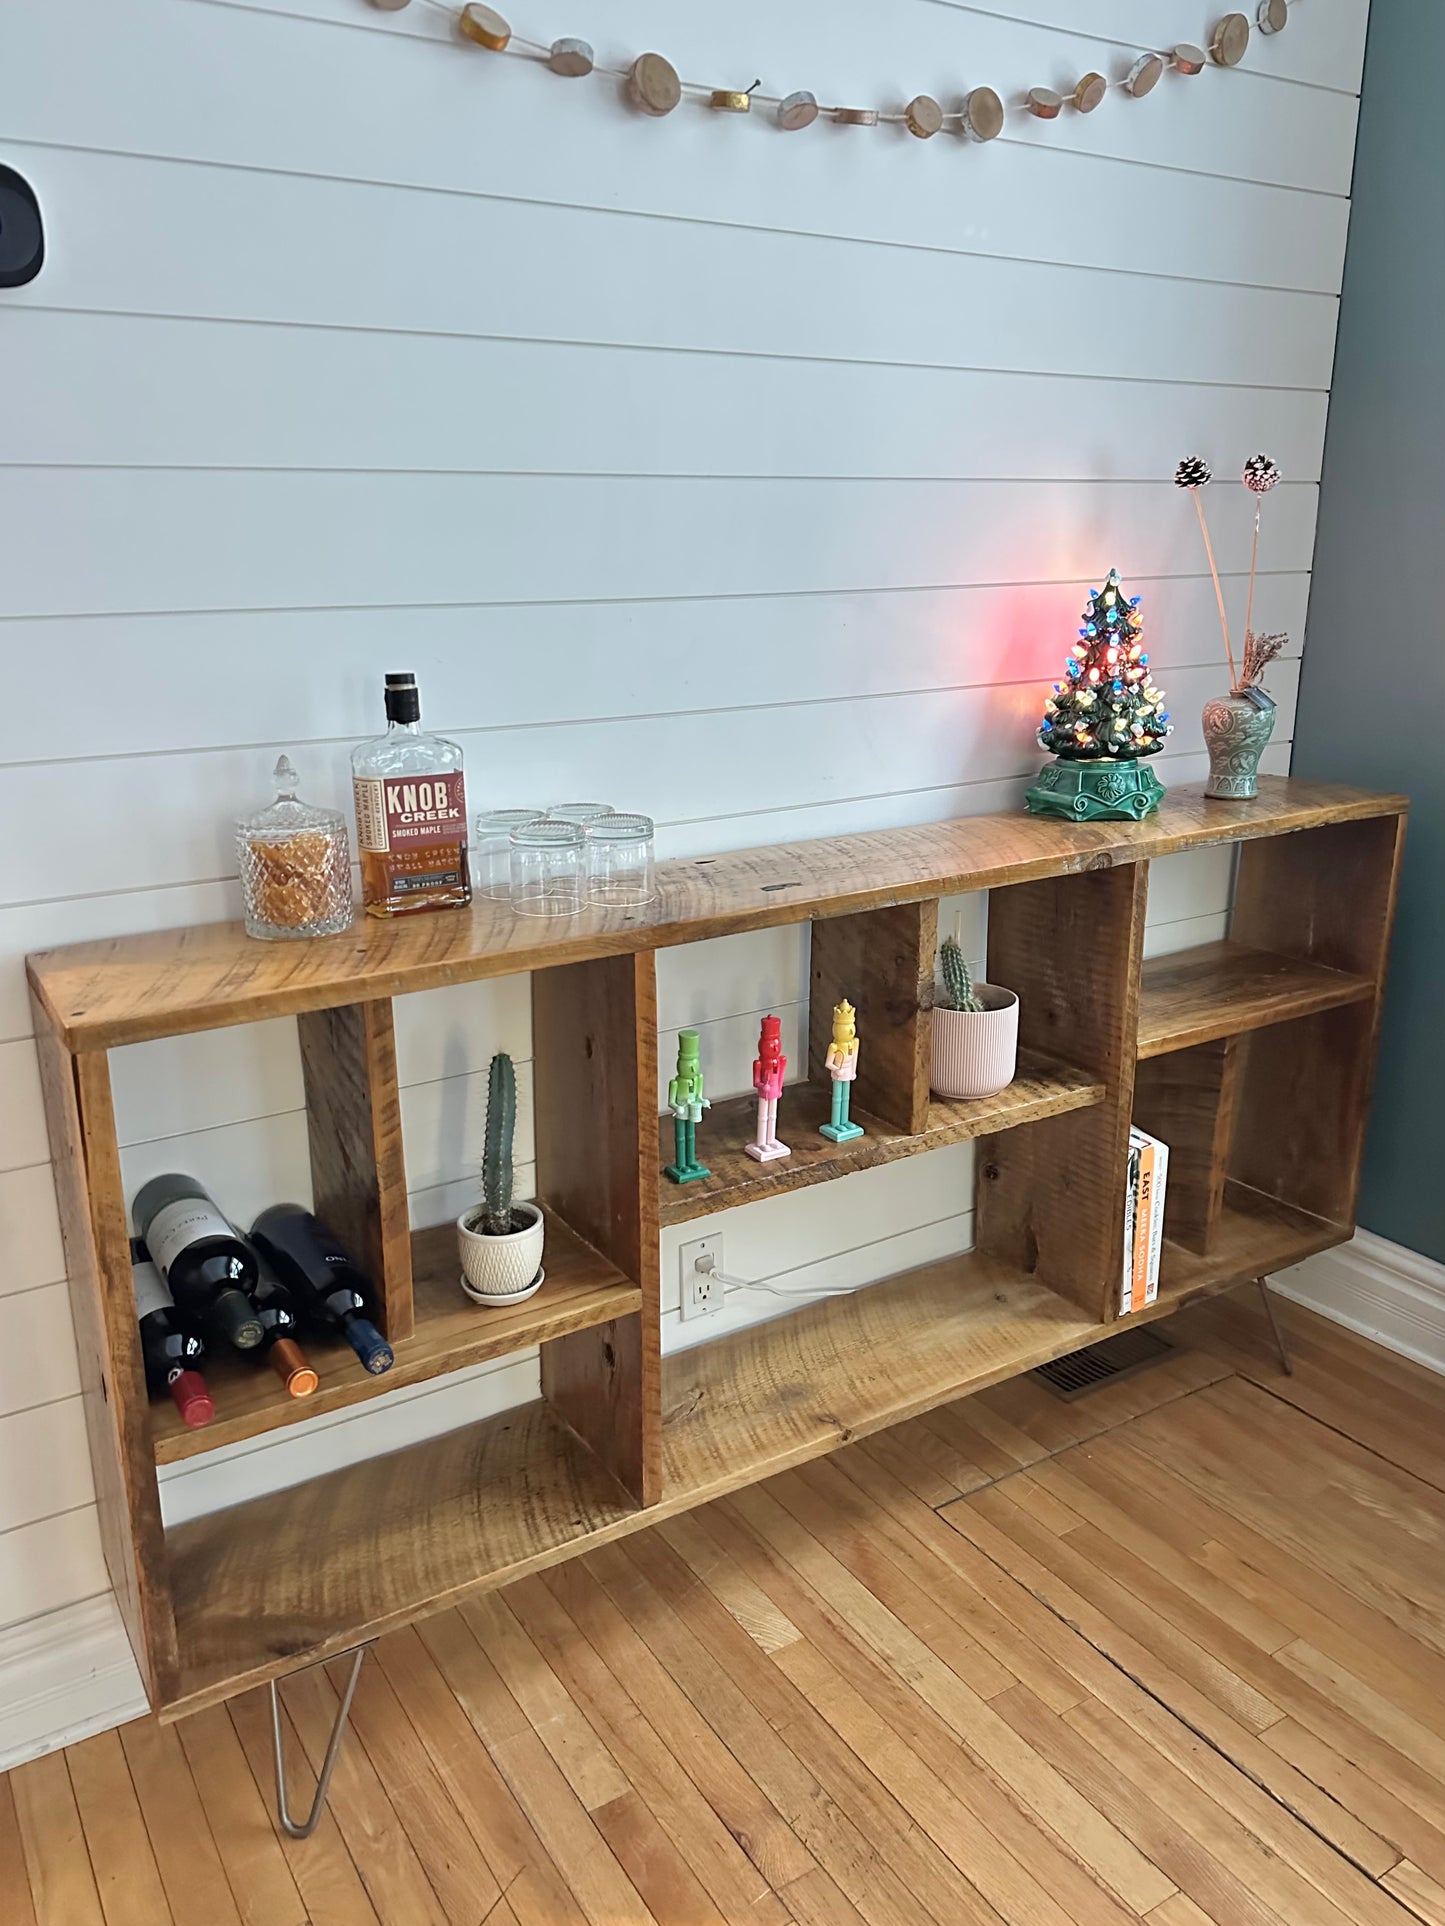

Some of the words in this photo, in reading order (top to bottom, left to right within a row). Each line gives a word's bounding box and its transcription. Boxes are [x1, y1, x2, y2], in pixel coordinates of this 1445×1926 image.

[361, 783, 370, 811] MAPLE
[387, 782, 448, 814] KNOB
[364, 813, 373, 847] SMOKED
[400, 807, 460, 824] CREEK
[392, 827, 419, 839] SMOKED
[420, 825, 442, 836] MAPLE
[1141, 1171, 1150, 1200] EAST
[1138, 1208, 1148, 1243] MEERA
[1136, 1244, 1146, 1281] SODHA
